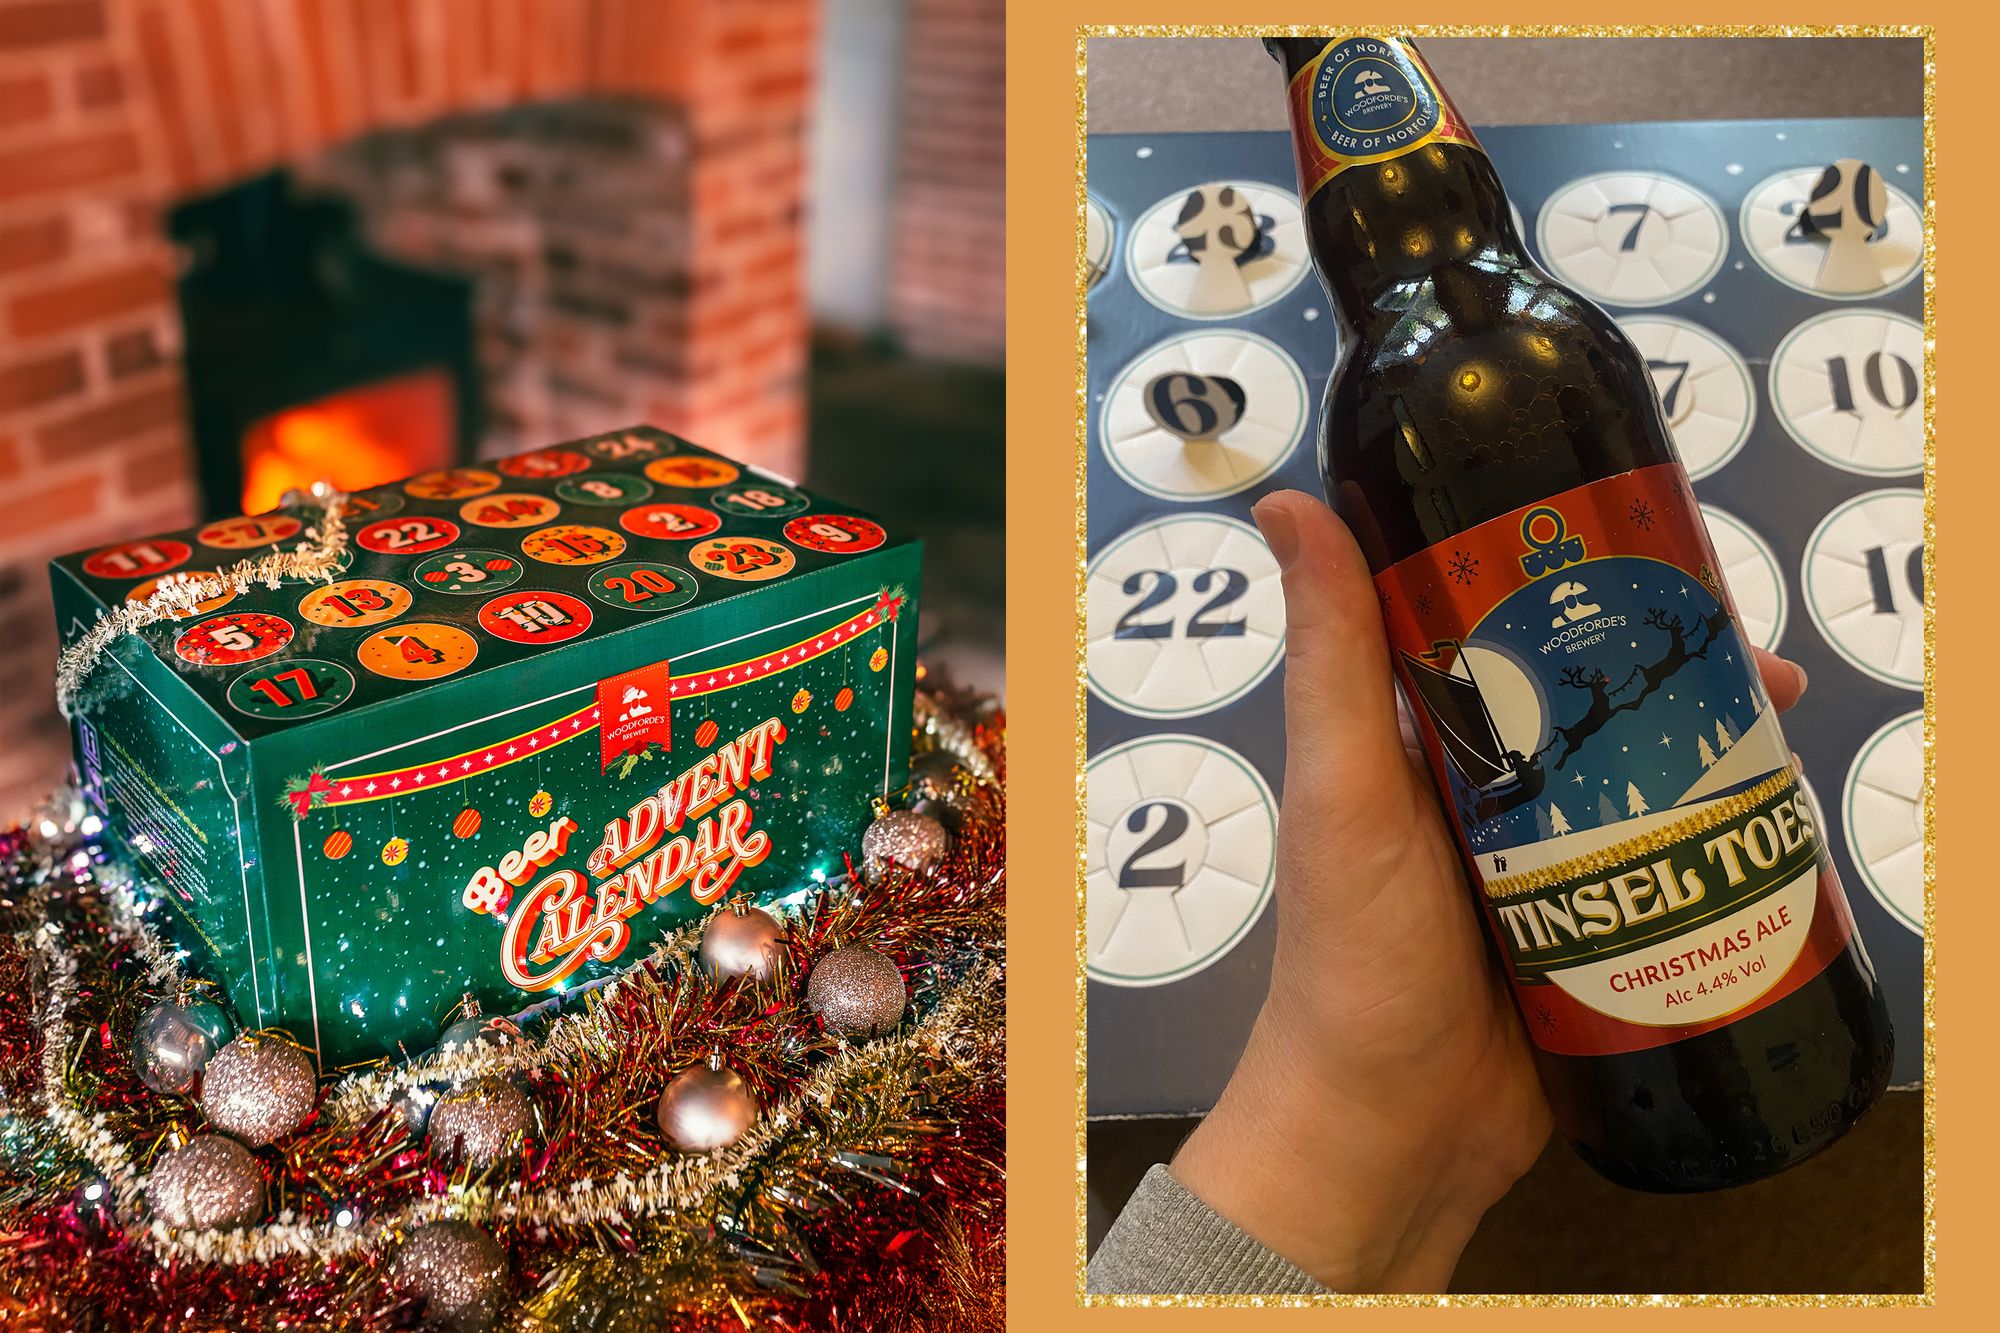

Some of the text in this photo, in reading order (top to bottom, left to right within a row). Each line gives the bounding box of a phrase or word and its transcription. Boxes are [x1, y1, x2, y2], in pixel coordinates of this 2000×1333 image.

[1318, 66, 1335, 98] BEER
[1335, 48, 1351, 63] OF
[1344, 94, 1409, 118] WOODFORDE'S
[1362, 102, 1393, 115] BREWERY
[1331, 107, 1433, 149] BEER OF NORFOLK
[1608, 202, 1651, 252] 7
[1826, 351, 1919, 413] 10
[580, 480, 623, 499] 8
[727, 489, 787, 511] 18
[372, 521, 443, 549] 22
[542, 533, 606, 559] 16
[808, 523, 856, 543] 9
[103, 544, 166, 571] 11
[444, 561, 489, 583] 3
[705, 543, 780, 574] 23
[604, 569, 677, 604] 20
[319, 587, 390, 618] 13
[1113, 568, 1250, 641] 22
[207, 624, 256, 652] 5
[400, 634, 442, 664] 4
[1538, 615, 1627, 655] WOODFORDE'S
[1565, 631, 1606, 654] BREWERY
[250, 667, 318, 708] 17
[606, 715, 665, 741] WOODFORDE'S
[622, 727, 650, 741] BREWERY
[587, 716, 788, 880] ADVENT
[1118, 802, 1189, 889] 2
[462, 816, 579, 915] Beer
[1497, 790, 1815, 952] TINSEL TOES
[500, 798, 773, 992] CALENDAR
[1609, 905, 1793, 993] CHRISTMAS ALE
[1665, 954, 1768, 1009] Alc 4.4% Vol
